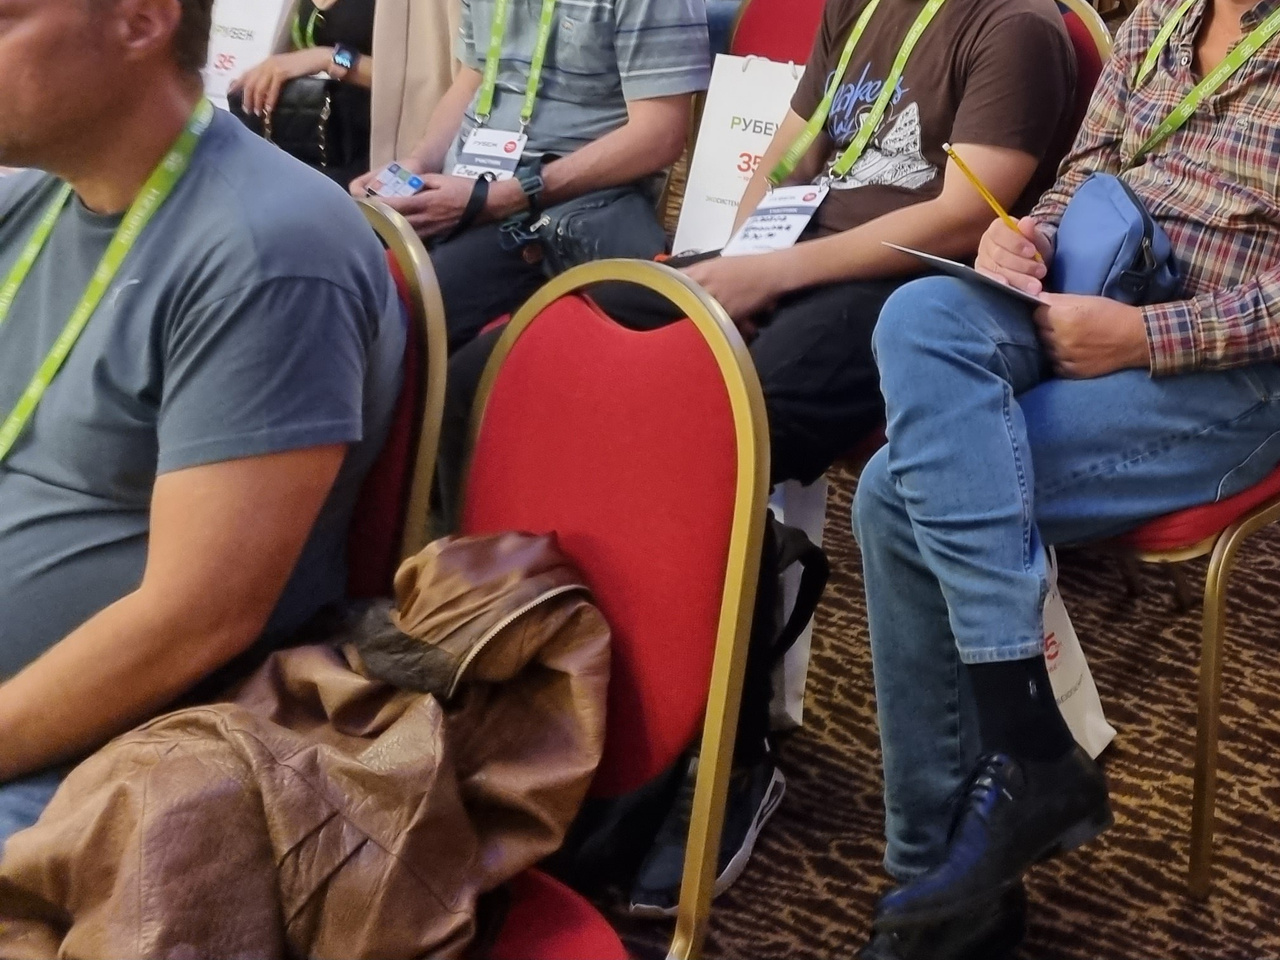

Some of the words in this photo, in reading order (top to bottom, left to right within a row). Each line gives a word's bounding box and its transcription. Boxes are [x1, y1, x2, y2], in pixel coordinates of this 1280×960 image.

[898, 21, 924, 57] RUBEZH
[1241, 43, 1254, 57] 35
[1199, 63, 1232, 96] RUBEZH
[1180, 103, 1193, 117] 35
[730, 116, 779, 136] РУБЕ
[1147, 124, 1172, 150] RUBEZ
[1044, 632, 1059, 660] 5
